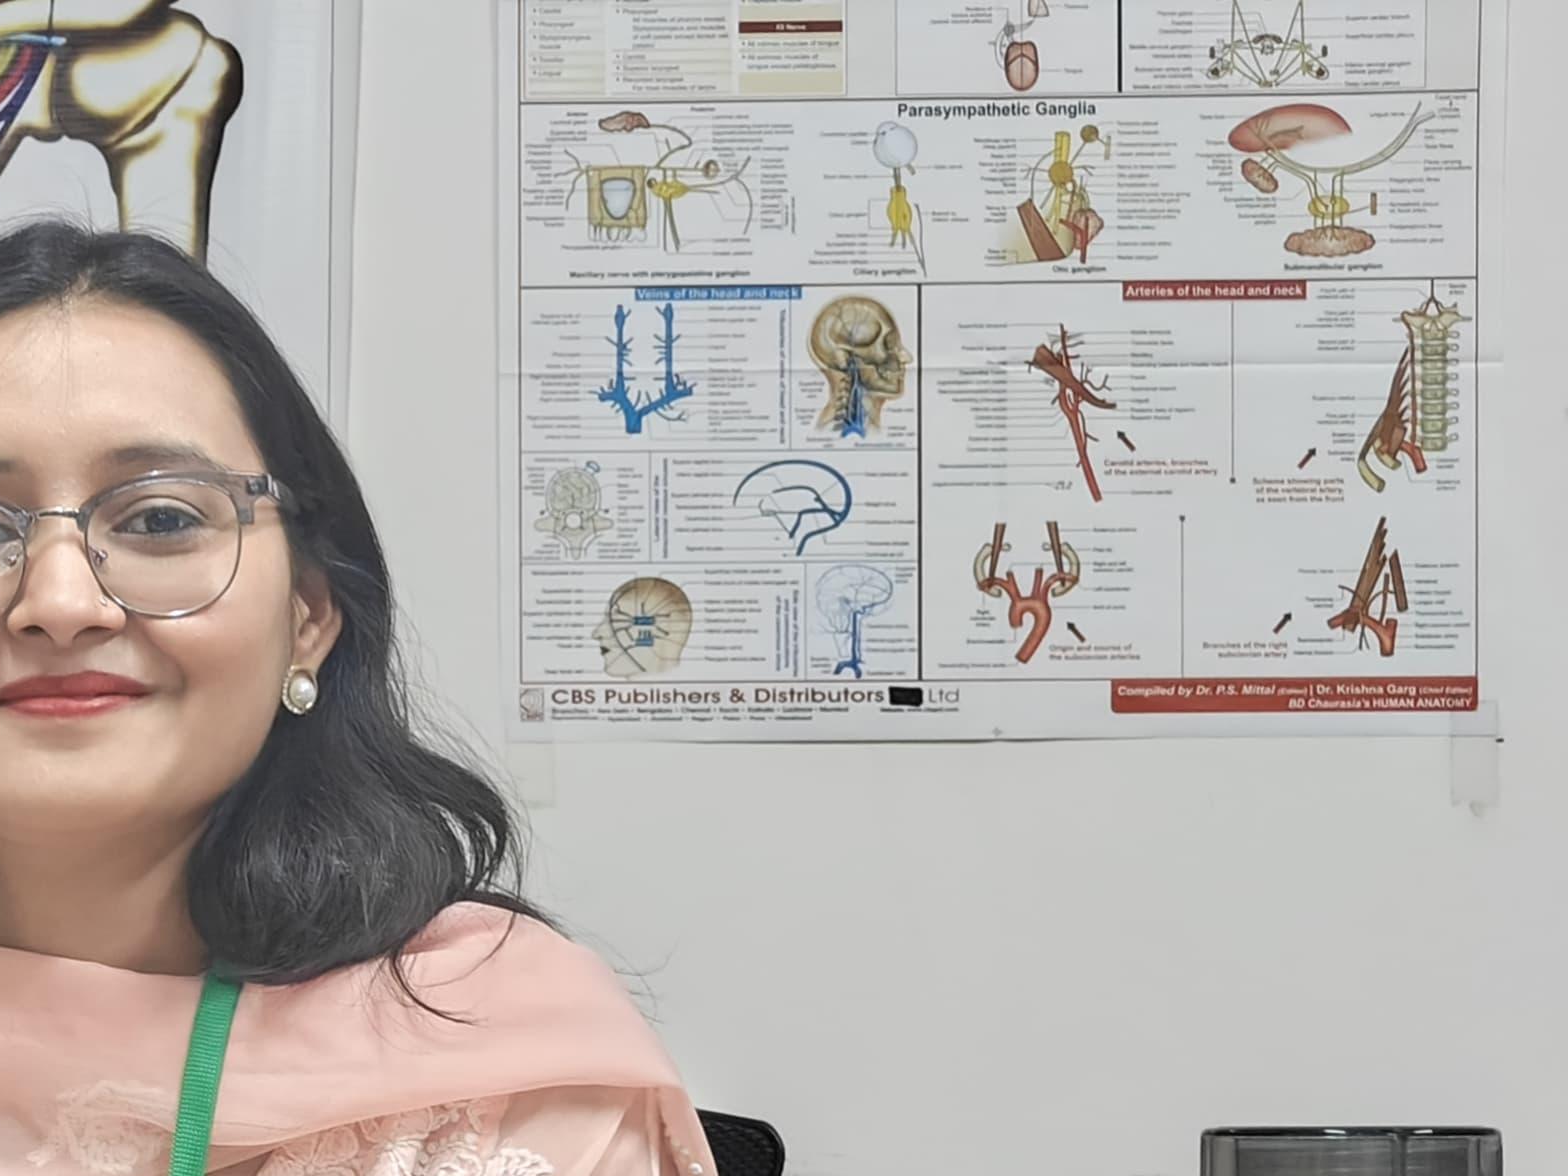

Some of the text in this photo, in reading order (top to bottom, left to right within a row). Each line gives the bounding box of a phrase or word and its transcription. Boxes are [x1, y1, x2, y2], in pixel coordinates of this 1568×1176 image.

[897, 101, 1097, 120] Parasympathetic Ganglia
[637, 288, 798, 300] Veins of the head and neck
[1126, 284, 1302, 298] Arteries of the head and neck
[552, 687, 960, 705] CBS Publishers & Distributors Ltd
[1118, 686, 1174, 697] Compiled
[1178, 686, 1193, 697] by
[1196, 686, 1212, 696] Dr.
[1242, 685, 1275, 695] Mittal
[1317, 685, 1334, 695] Dr.
[1337, 685, 1383, 695] Krishna
[1386, 685, 1417, 697] Garg
[1289, 698, 1305, 708] BD
[1373, 698, 1413, 708] HUMAN
[1417, 697, 1472, 708] ANATOMY
